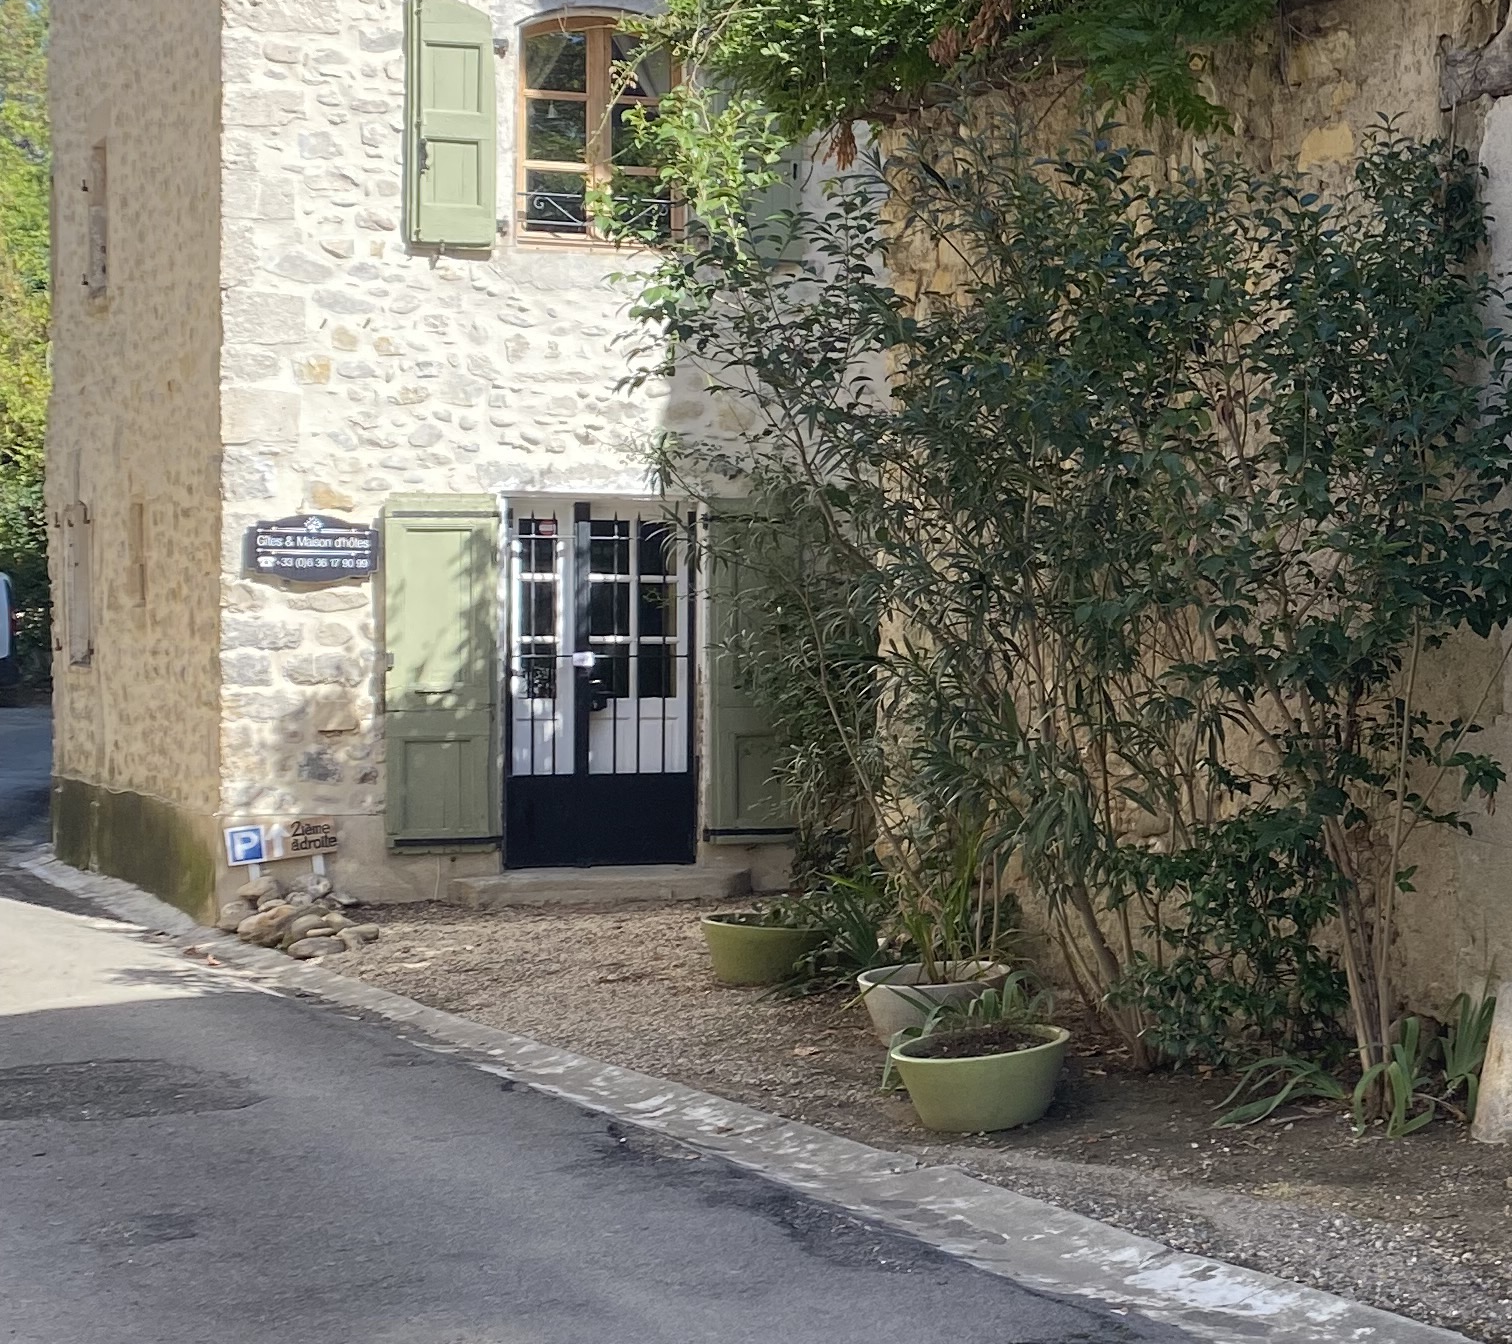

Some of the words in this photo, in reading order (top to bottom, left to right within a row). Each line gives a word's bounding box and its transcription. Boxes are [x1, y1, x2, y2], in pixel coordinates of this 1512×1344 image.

[285, 536, 295, 547] &
[296, 536, 332, 548] Maison
[276, 557, 294, 567] +33
[232, 831, 259, 861] P
